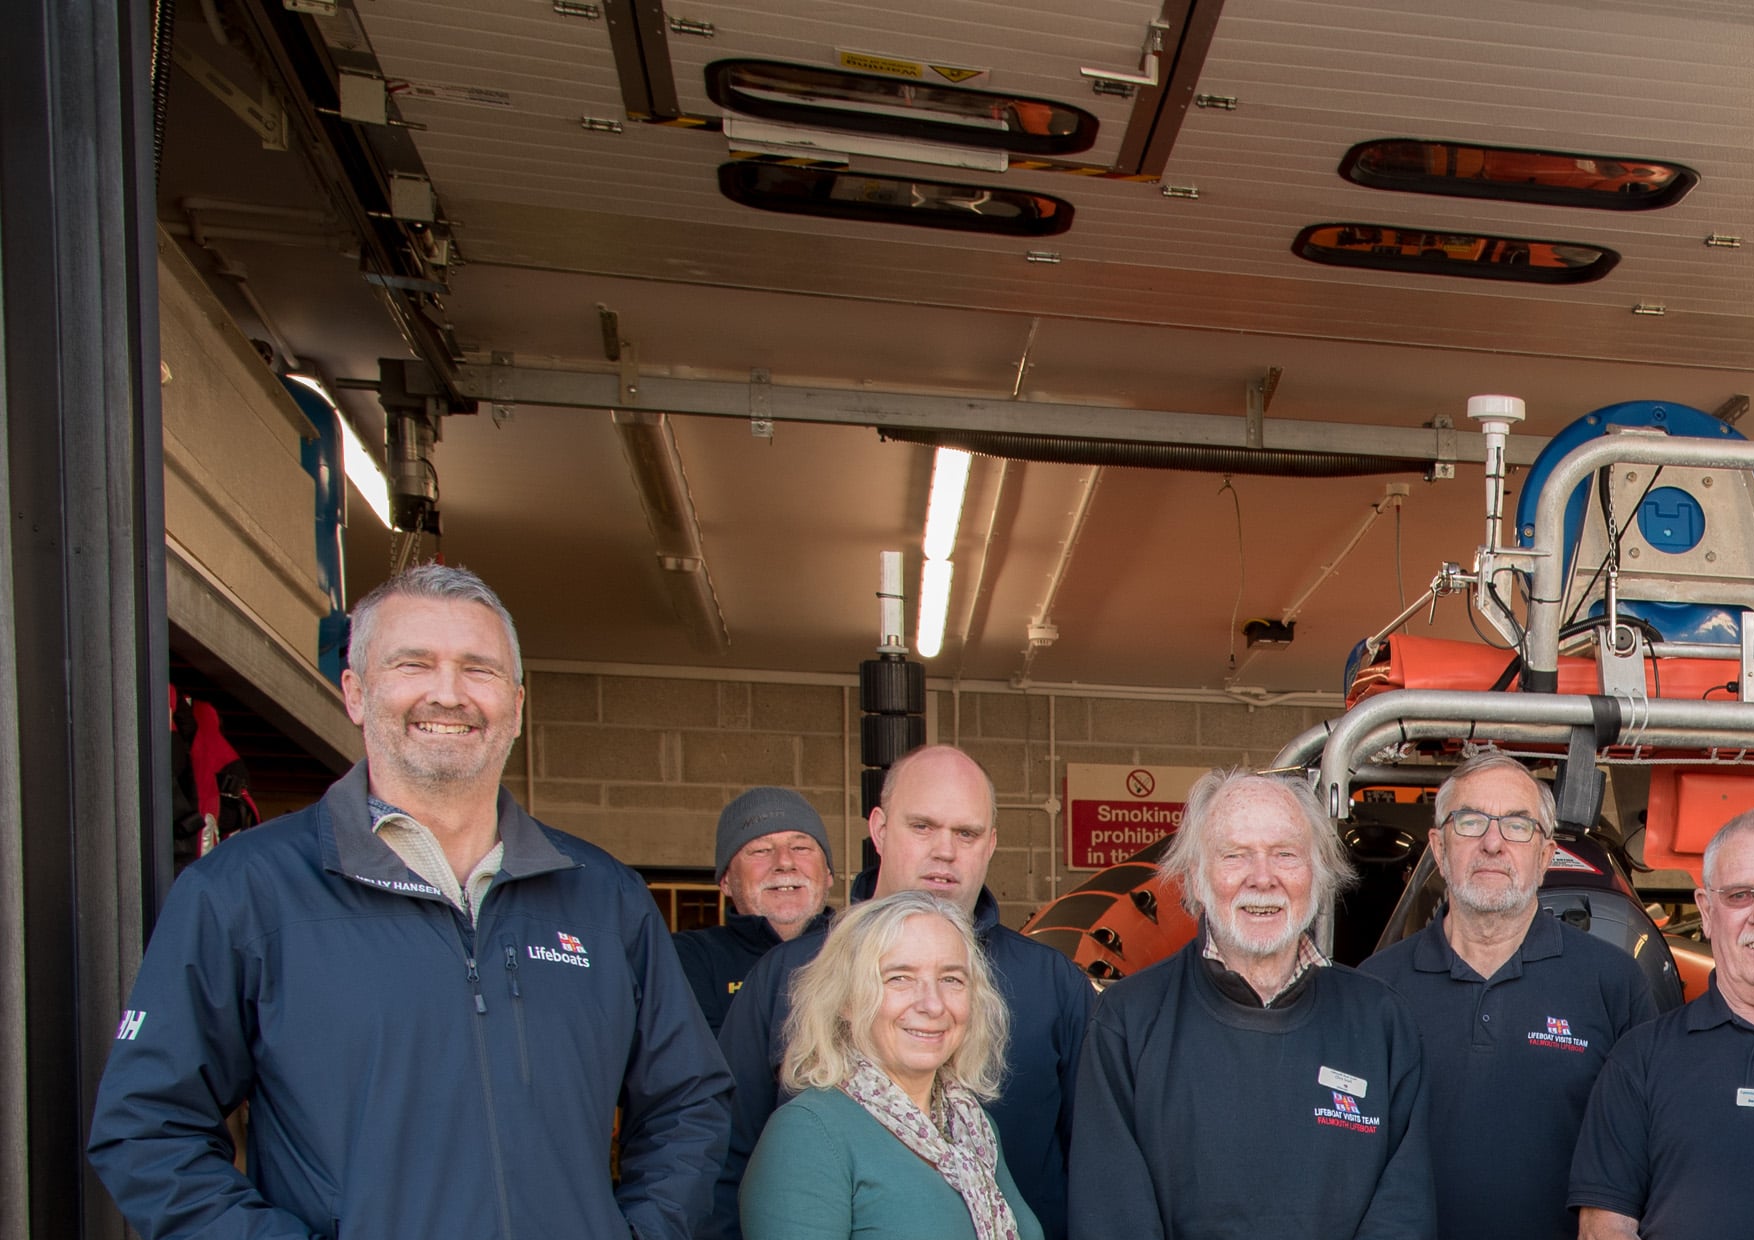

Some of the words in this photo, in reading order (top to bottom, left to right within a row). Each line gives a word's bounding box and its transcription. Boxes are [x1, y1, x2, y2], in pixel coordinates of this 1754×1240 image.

[1098, 805, 1183, 827] Smoking
[1088, 848, 1104, 864] in
[394, 882, 441, 896] HANSEN
[528, 945, 590, 968] Lifeboats
[1528, 1032, 1554, 1040] LIFEBOAT
[1555, 1036, 1572, 1044] VISITS
[1573, 1038, 1588, 1048] TEAM
[1314, 1108, 1343, 1118] LIFEBOAT
[1343, 1112, 1361, 1122] VISITS
[1362, 1116, 1380, 1126] TEAM
[1317, 1117, 1350, 1128] FALMOUTH
[1350, 1124, 1377, 1134] LIFEBOAT
